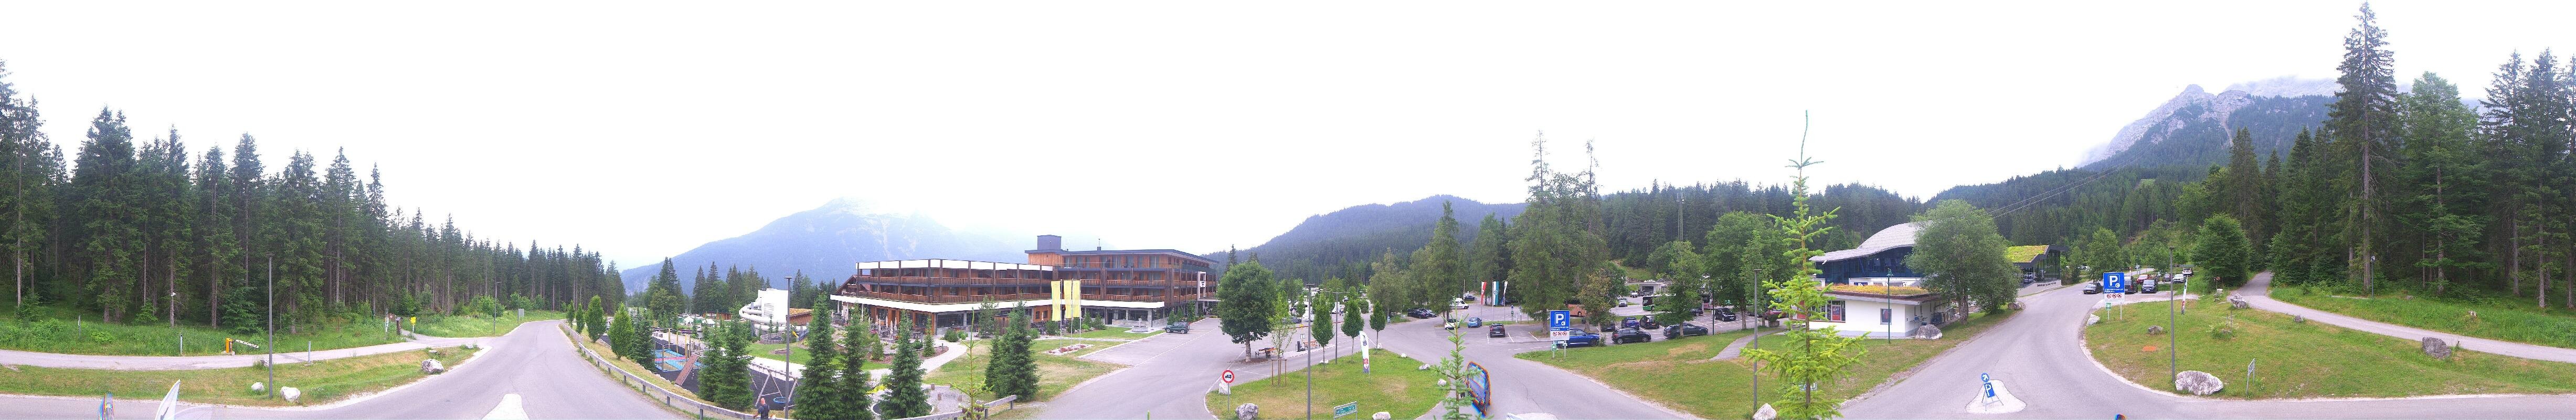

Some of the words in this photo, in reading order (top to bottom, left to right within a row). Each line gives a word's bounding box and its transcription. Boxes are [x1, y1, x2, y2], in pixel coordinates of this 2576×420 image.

[2109, 276, 2118, 286] P
[1556, 314, 1564, 324] P
[1985, 384, 1991, 397] P
